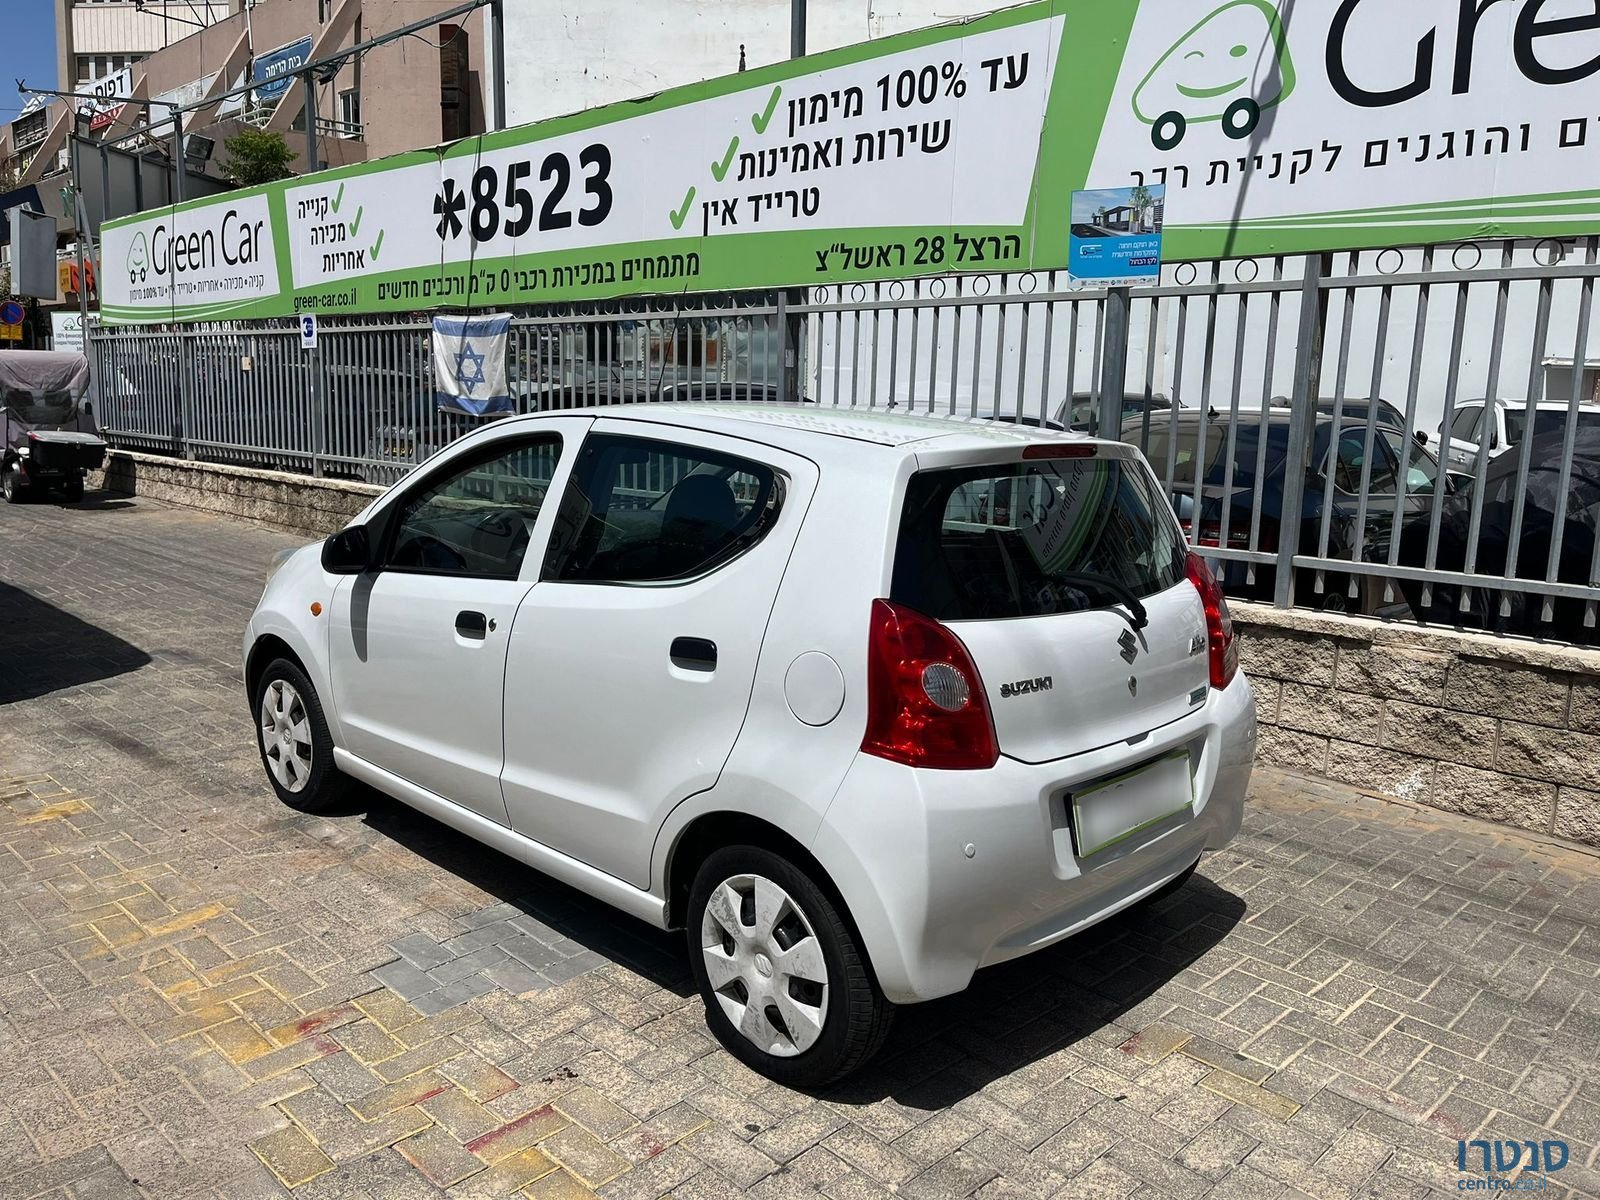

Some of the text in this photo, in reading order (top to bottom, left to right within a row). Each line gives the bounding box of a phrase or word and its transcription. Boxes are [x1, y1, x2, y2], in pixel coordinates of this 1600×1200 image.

[787, 52, 1030, 138] עד 100% מימון
[737, 118, 952, 182] שירות ואמינות
[1363, 123, 1531, 168] והוגנים
[1205, 140, 1343, 185] לקניית
[298, 196, 329, 222] קנייה
[702, 186, 820, 237] טרייד אין
[152, 209, 264, 276] Green Car
[311, 222, 346, 246] מכירה
[953, 232, 1021, 262] הרצל
[322, 249, 365, 273] אחריות
[913, 235, 946, 265] 28
[514, 268, 547, 291] רכבי
[551, 261, 616, 288] במכירת
[621, 252, 700, 281] מתמחים
[197, 280, 219, 293] אחריות
[223, 276, 244, 290] מכירה
[248, 274, 264, 291] קניה
[378, 280, 419, 300] חדשים
[422, 275, 465, 296] ורכבים
[500, 268, 510, 292] 0
[293, 287, 357, 313] green-car.co.il
[999, 676, 1053, 699] SUZUKI
